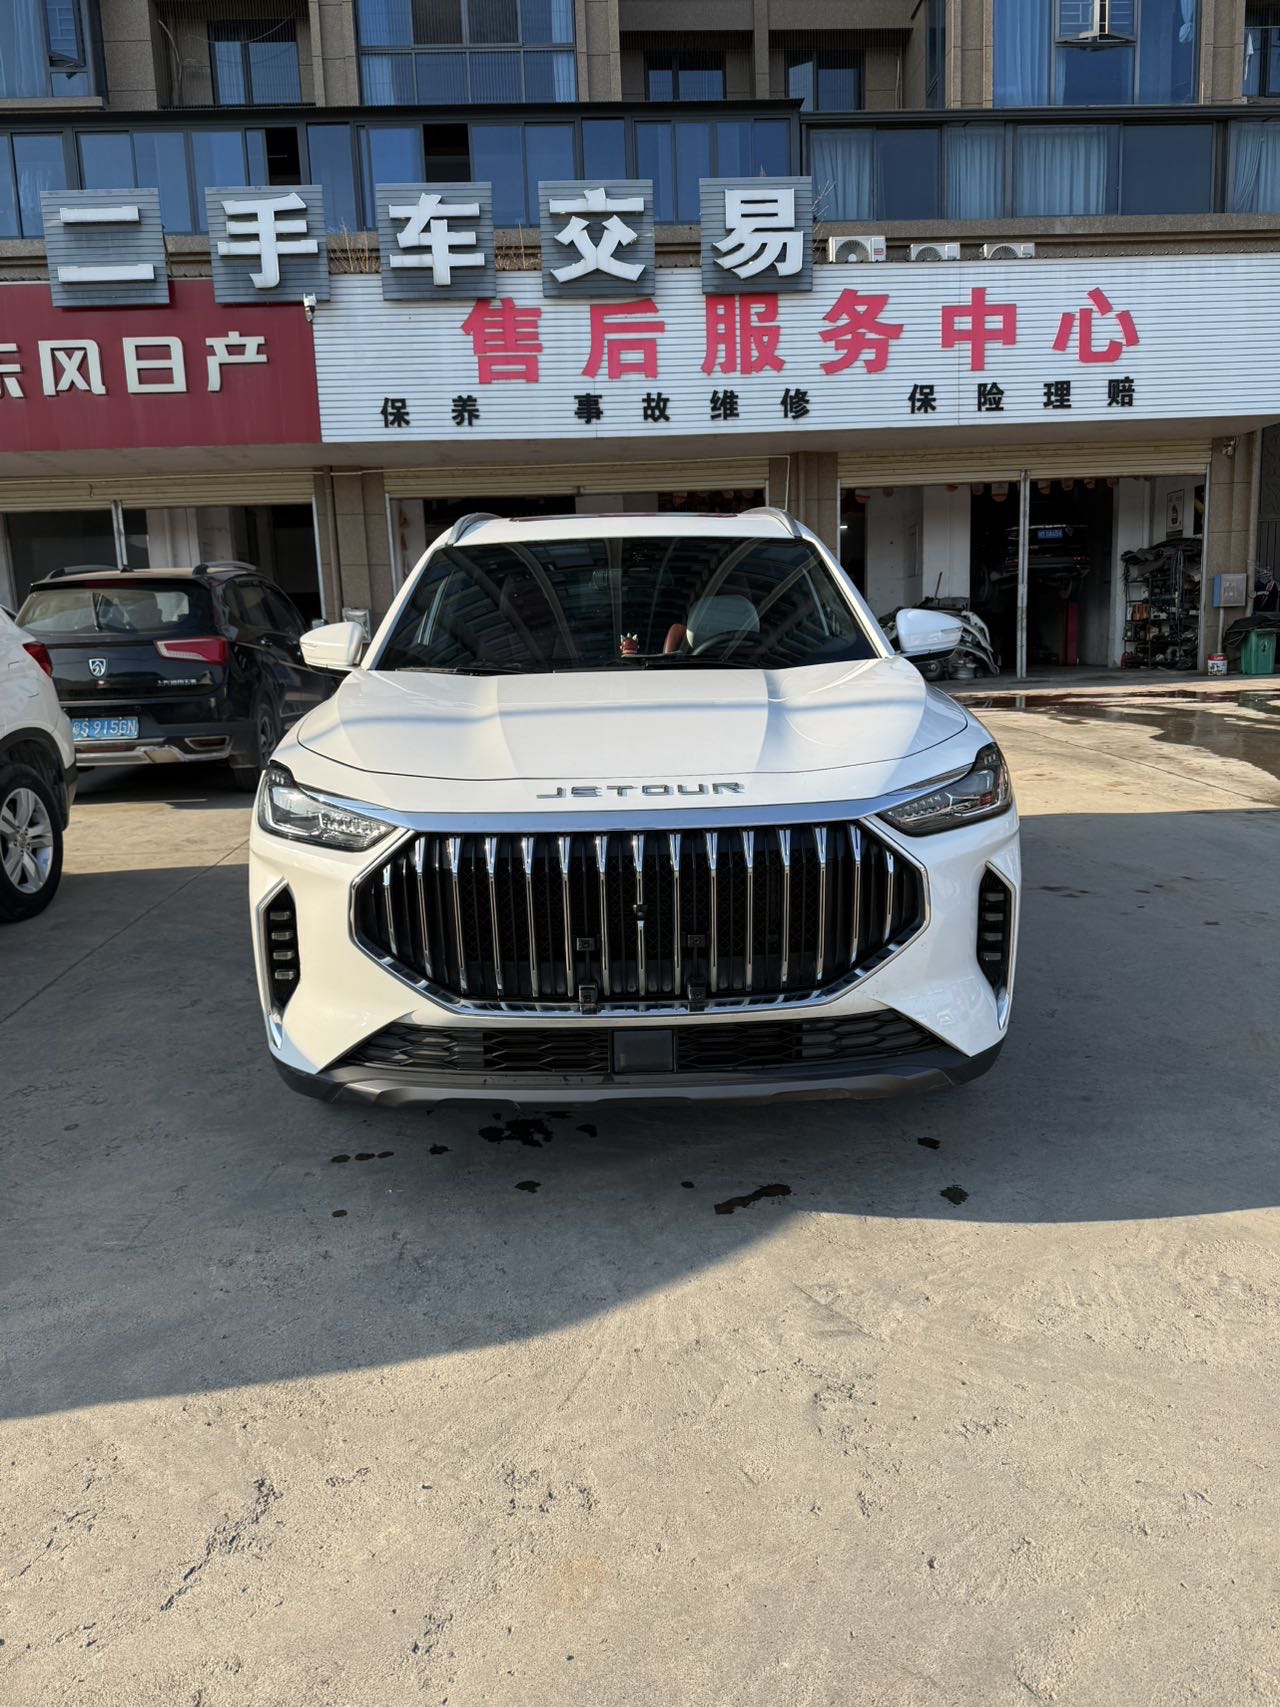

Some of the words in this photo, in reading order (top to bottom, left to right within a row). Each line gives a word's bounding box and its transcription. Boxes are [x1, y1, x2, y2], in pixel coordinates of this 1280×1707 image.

[58, 188, 804, 289] 二手车交易
[461, 287, 1139, 384] 售后服务中心
[380, 396, 480, 428] 保养
[574, 388, 810, 424] 事故维修
[908, 377, 1135, 414] 保险理赔
[536, 782, 745, 799] JETOUR
